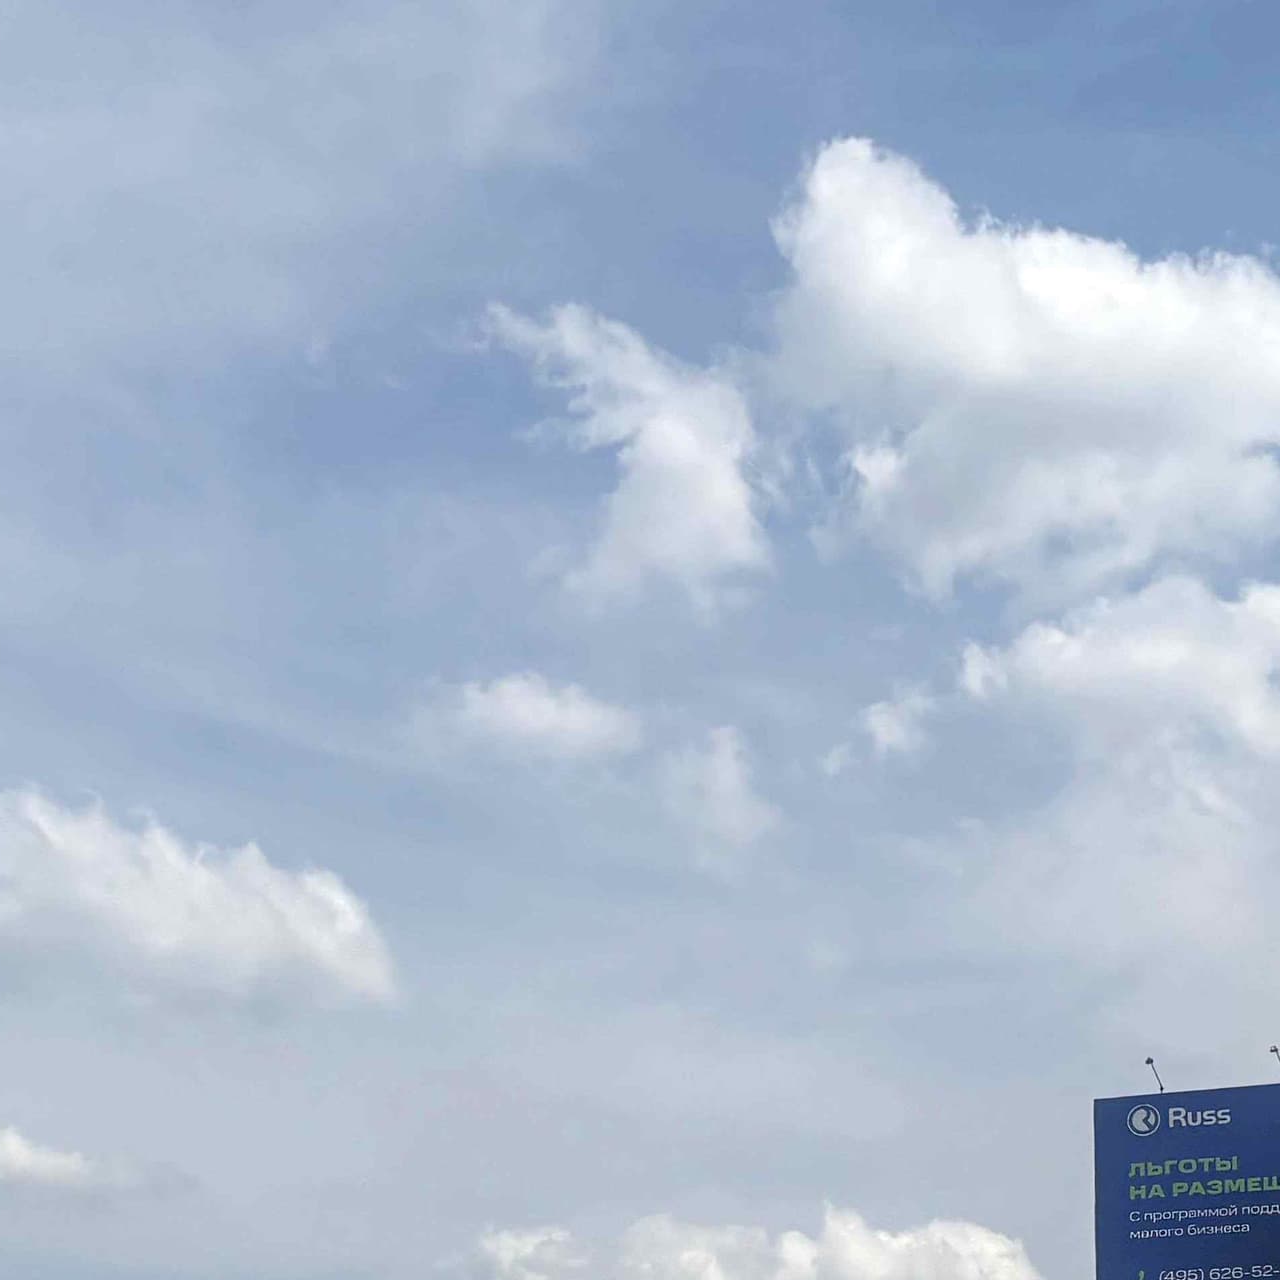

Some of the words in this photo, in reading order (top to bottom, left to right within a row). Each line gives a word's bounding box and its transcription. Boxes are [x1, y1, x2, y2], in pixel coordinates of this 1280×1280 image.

[1168, 1107, 1231, 1128] Russ
[1128, 1156, 1239, 1178] ЛЬГОТЫ
[1129, 1184, 1165, 1200] НА
[1128, 1211, 1141, 1222] С
[1143, 1204, 1238, 1223] программой
[1129, 1227, 1184, 1240] малого
[1187, 1223, 1250, 1236] бизнеса
